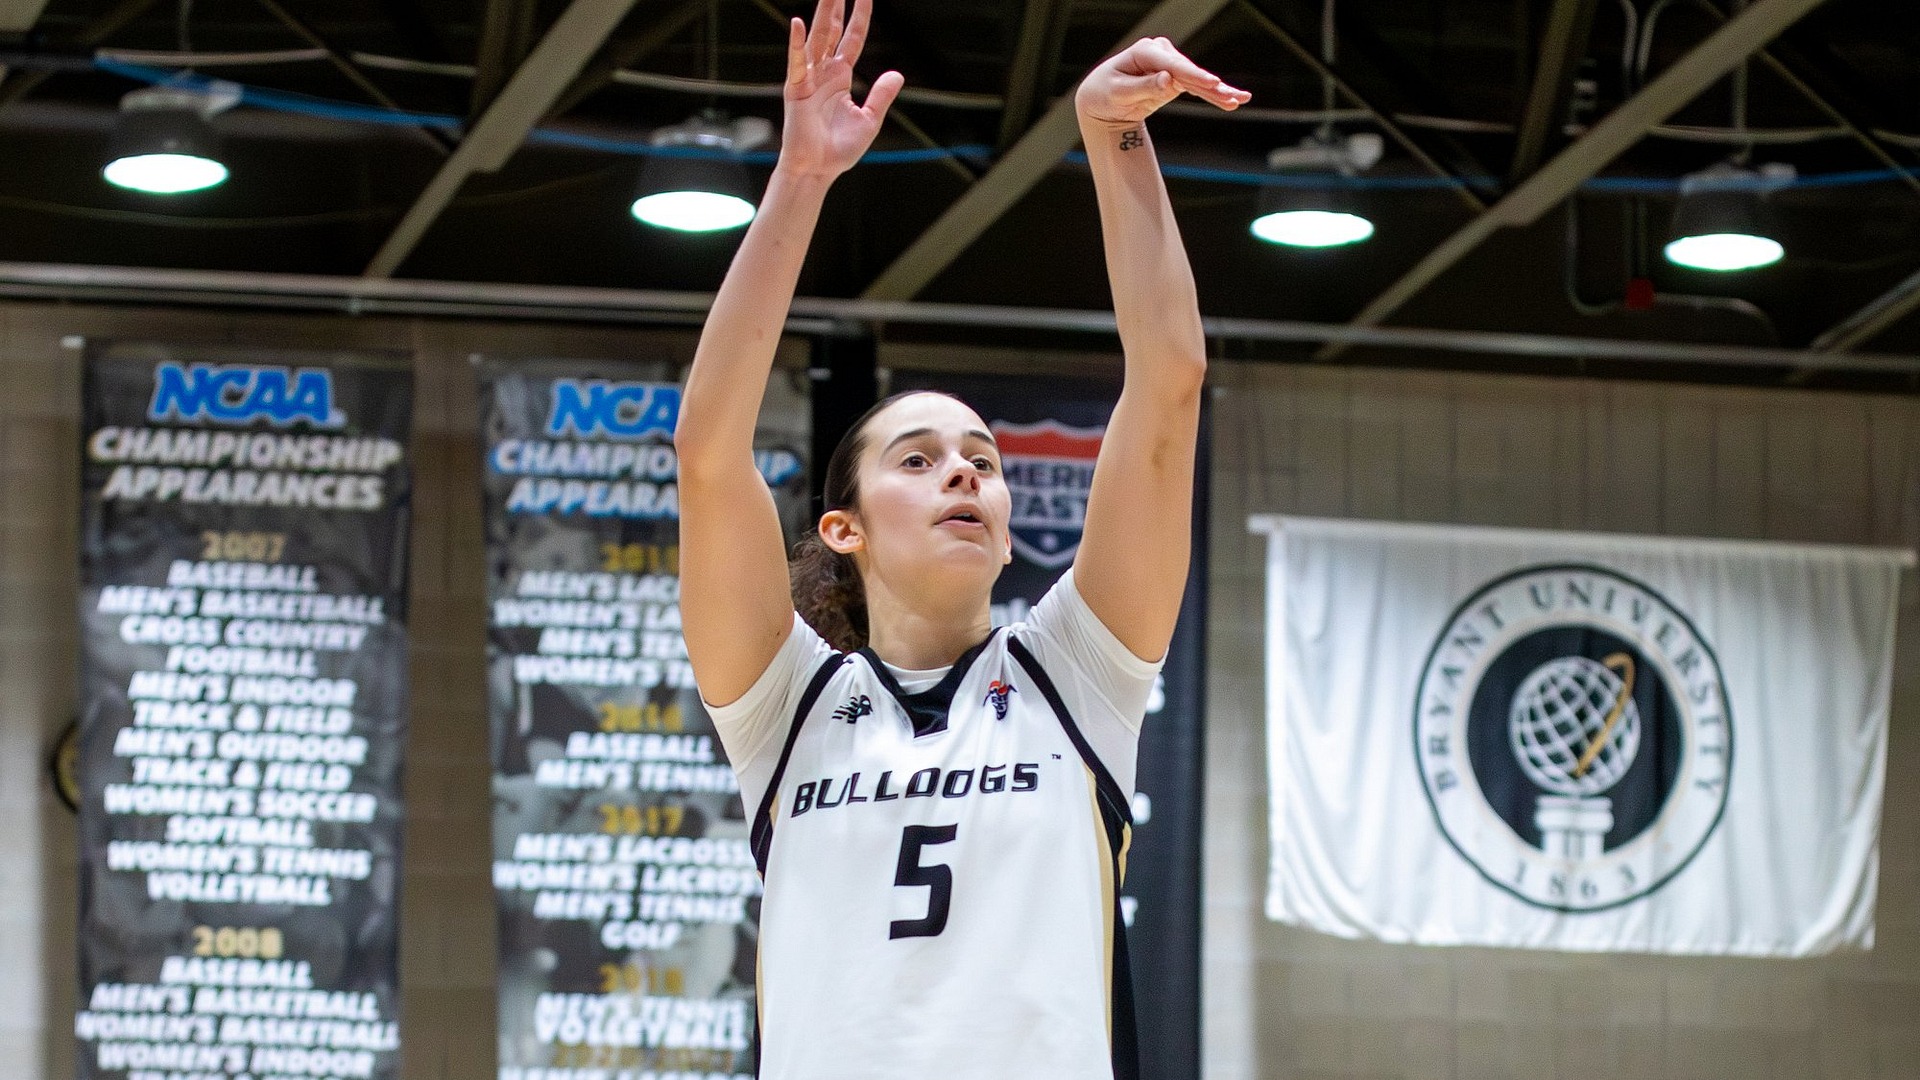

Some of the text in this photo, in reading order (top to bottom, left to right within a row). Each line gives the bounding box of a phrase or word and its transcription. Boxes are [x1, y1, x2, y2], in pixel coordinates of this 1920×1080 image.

[149, 362, 334, 425] NCAA
[550, 379, 684, 437] NCA
[89, 426, 402, 472] CHAMPIONSHIP
[101, 465, 385, 510] APPEARANCES
[505, 477, 679, 520] APPEARA
[166, 560, 318, 591] BASEBALL
[515, 572, 617, 600] MEN'S
[97, 585, 385, 625] MEN'S BASKETBALL
[494, 600, 641, 629] WOMEN'S
[119, 615, 368, 650] CROSS COUNTRY
[536, 628, 636, 655] MEN'S
[164, 645, 318, 678] FOOTBALL
[513, 655, 661, 685] WOMEN'S
[127, 671, 357, 706] MEN'S INDOOR
[1428, 578, 1724, 795] BRYANT UNIVERSITY
[132, 701, 354, 736] TRACK & FIELD
[113, 727, 369, 765] MEN'S OUTDOOR
[565, 731, 715, 764] BASEBALL
[131, 757, 352, 792] TRACK & FIELD
[535, 759, 633, 791] MEN'S
[791, 763, 1039, 818] BULLDOGS
[103, 783, 378, 823] WOMEN'S SOCCER
[600, 803, 685, 836] 2017
[165, 815, 314, 847] SOFTBALL
[513, 833, 614, 863] MEN'S
[107, 840, 373, 880] WOMEN'S TENNIS
[147, 872, 332, 906] VOLLEYBALL
[491, 860, 763, 896] WOMEN'S LACROS
[889, 823, 958, 940] 5
[1512, 860, 1638, 899] 1863
[533, 890, 747, 924] MEN'S TENNIS
[193, 925, 283, 960] 2008
[600, 920, 684, 951] GOLF
[160, 955, 314, 990] BASEBALL
[89, 982, 380, 1022] MEN'S BASKETBALL
[75, 1010, 399, 1052] WOMEN'S BASKETBALL
[98, 1040, 375, 1079] WOMEN'S INDOOR
